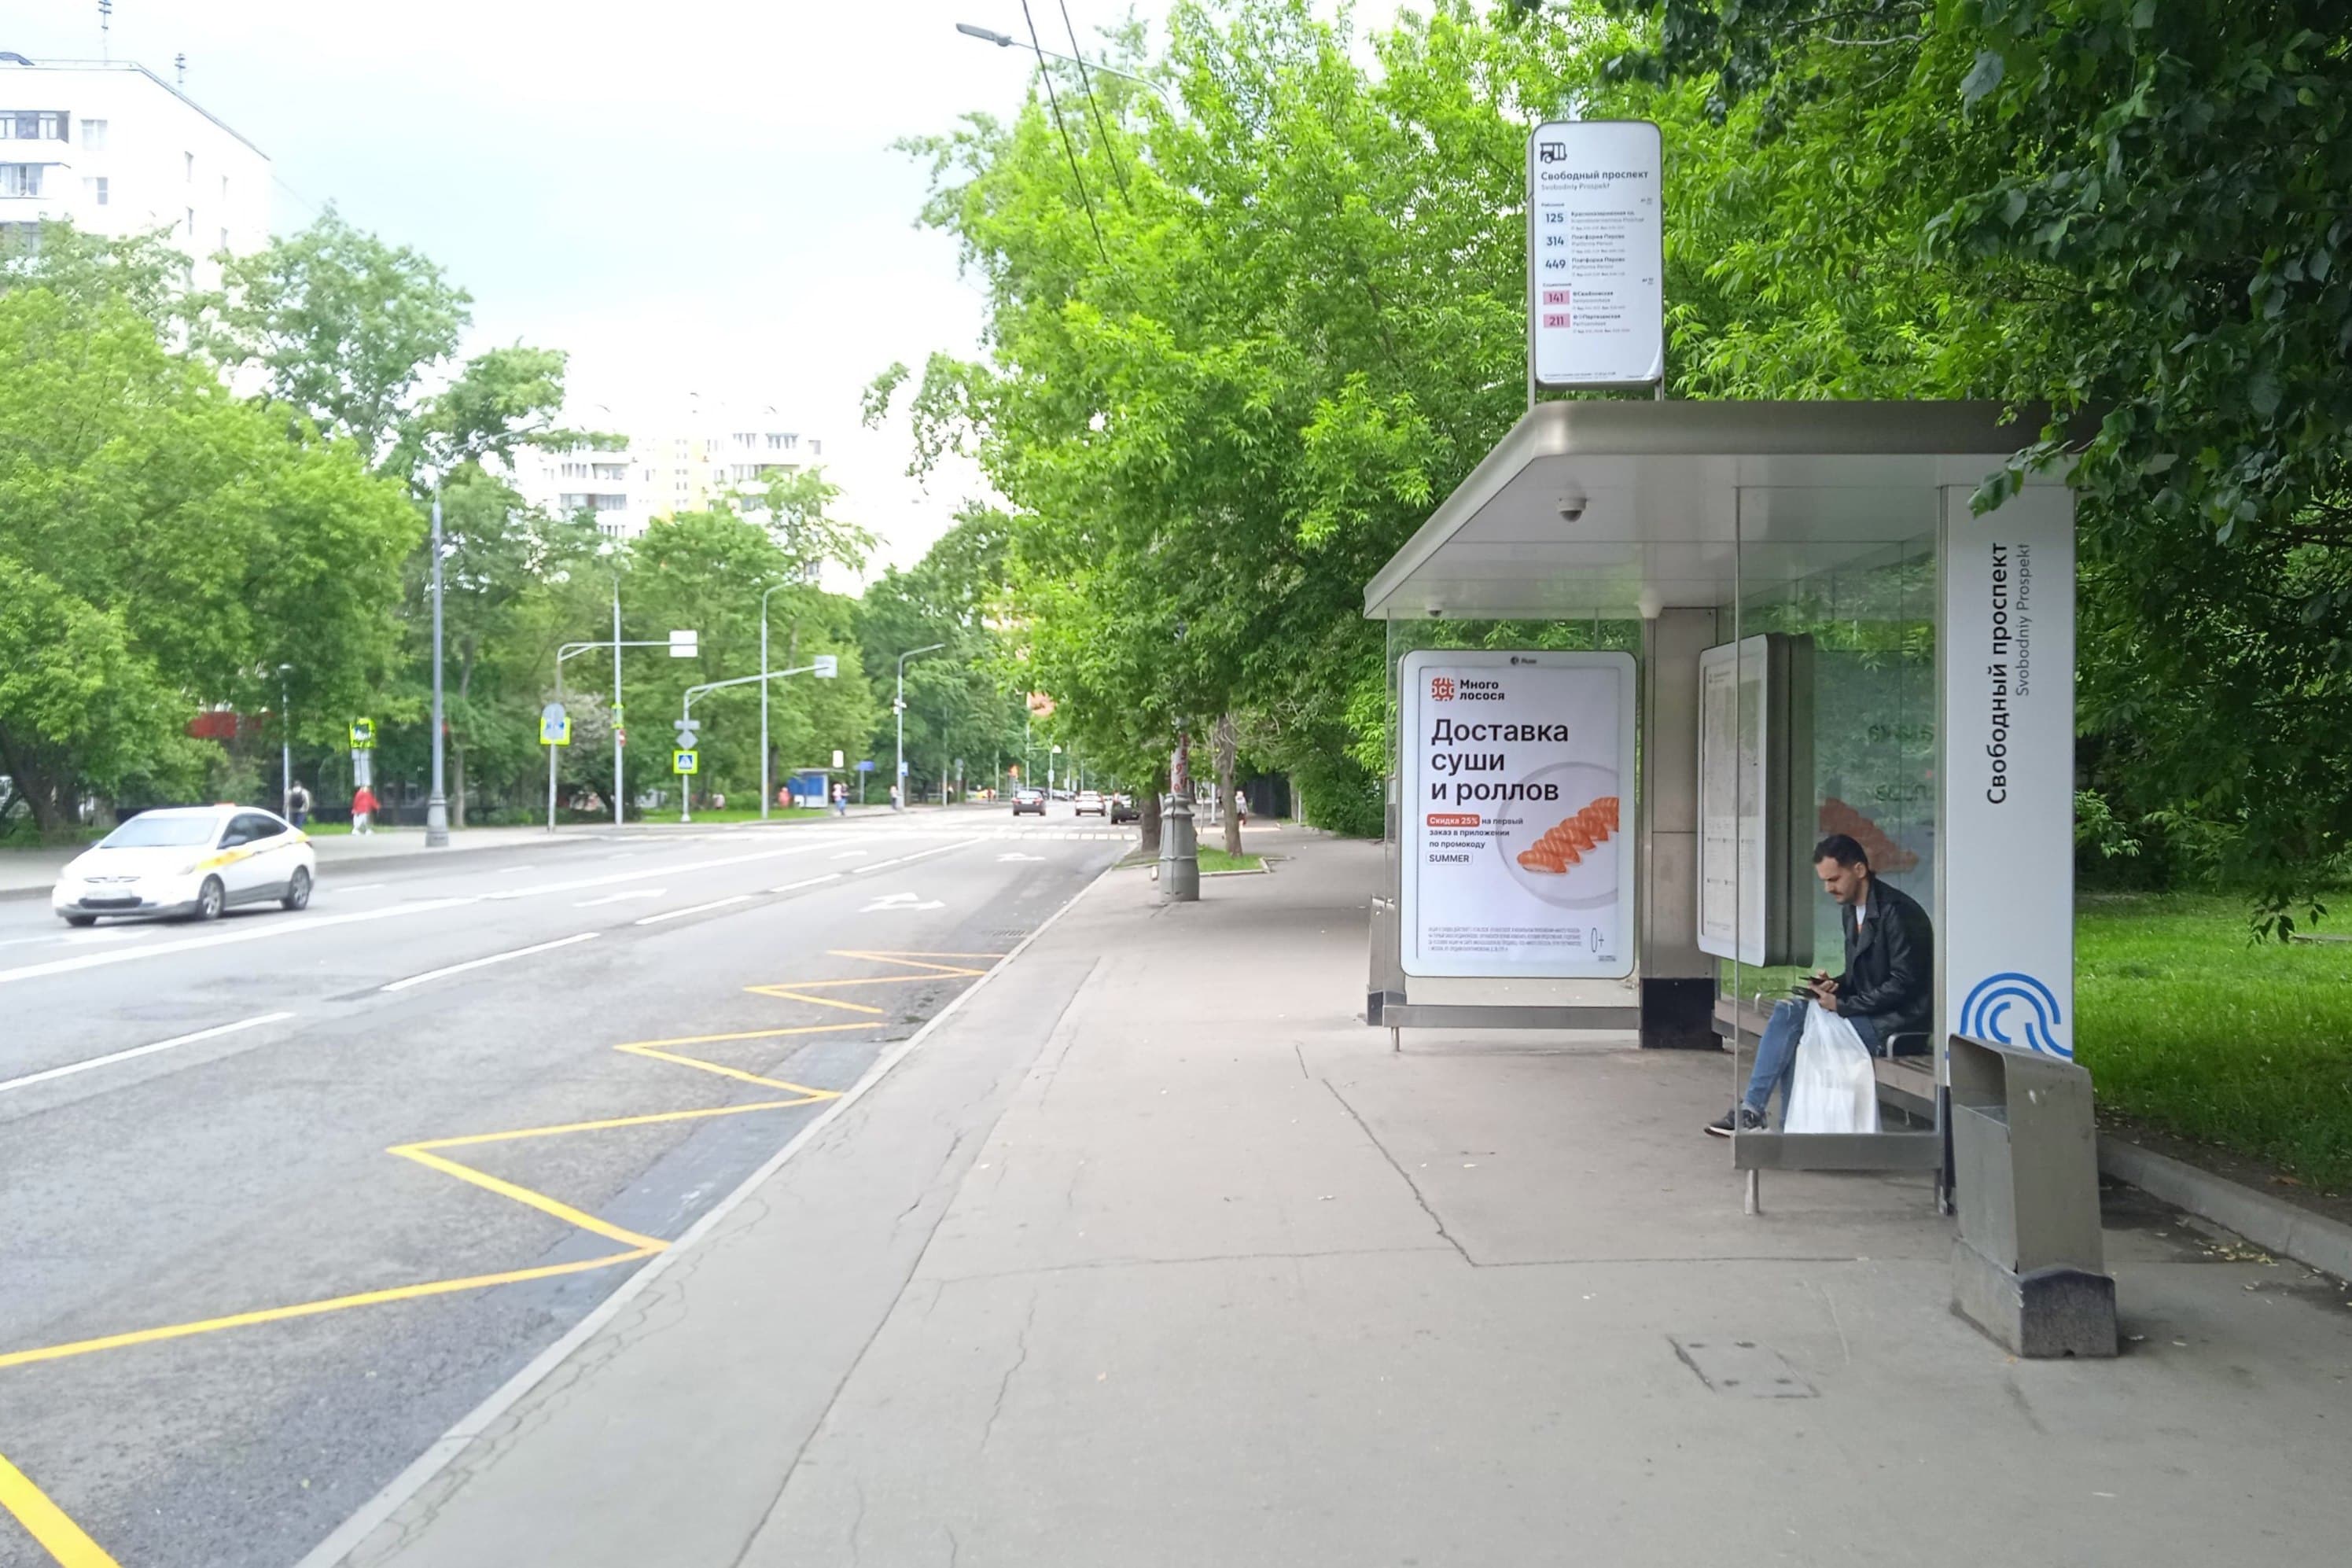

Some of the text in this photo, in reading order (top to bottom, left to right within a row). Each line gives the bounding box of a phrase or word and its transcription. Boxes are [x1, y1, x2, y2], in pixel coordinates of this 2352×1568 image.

[1541, 171, 1648, 181] Свободный проспект
[1546, 212, 1564, 223] 125
[1547, 236, 1564, 246] 314
[1545, 259, 1566, 270] 449
[1548, 293, 1563, 303] 141
[1549, 315, 1564, 326] 211
[2016, 543, 2033, 696] Svobodniy Prospekt
[1986, 543, 2012, 804] Свободный проспект
[1459, 679, 1500, 690] Много
[1459, 692, 1505, 701] лосося
[1432, 720, 1568, 745] Доставка
[1432, 754, 1504, 776] суши
[1432, 783, 1559, 805] и роллов
[1429, 816, 1460, 826] Скидка
[1460, 816, 1478, 825] 25%
[1429, 854, 1470, 863] SUMMER
